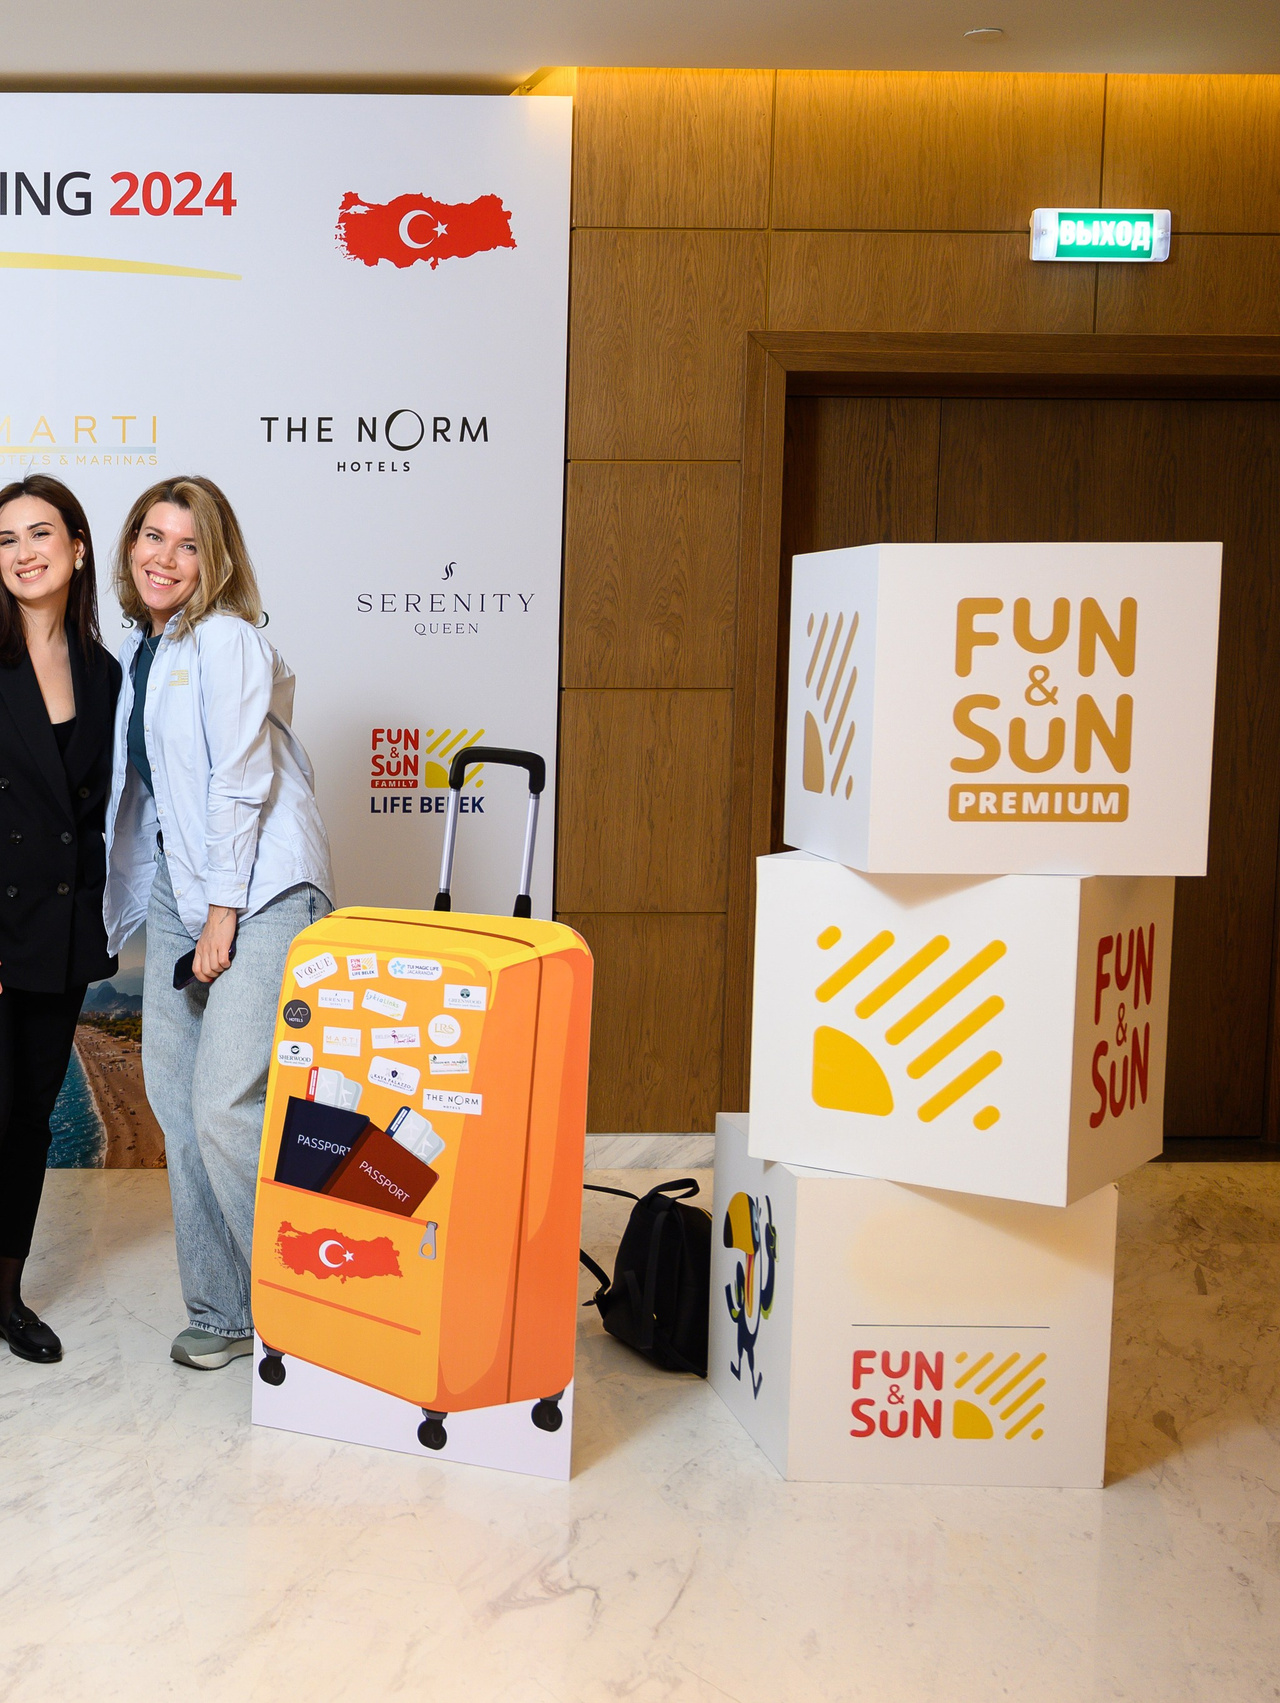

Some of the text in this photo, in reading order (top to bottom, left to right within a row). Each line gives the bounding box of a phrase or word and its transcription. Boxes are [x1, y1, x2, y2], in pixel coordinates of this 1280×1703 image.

[110, 171, 237, 217] 2024
[1060, 220, 1150, 251] ВЫХОД
[260, 408, 489, 451] THE NORM
[59, 455, 69, 465] &
[76, 455, 158, 466] MARINAS
[337, 461, 411, 472] HOTELS
[357, 593, 535, 613] SERENITY
[414, 623, 479, 635] QUEEN
[955, 597, 1137, 677] FUN
[1025, 665, 1059, 706] &
[372, 729, 419, 750] FUN
[950, 694, 1134, 773] SUN
[371, 754, 418, 776] SUN
[390, 747, 399, 758] &
[371, 797, 412, 813] LIFE
[958, 792, 1119, 815] PREMIUM
[1094, 922, 1155, 1026] FUN
[1116, 1002, 1128, 1047] &
[1089, 1021, 1150, 1129] SUN
[427, 1093, 479, 1106] THE NORM
[359, 1160, 410, 1203] PASSPORT
[852, 1350, 944, 1391] FUN
[888, 1384, 905, 1405] &
[850, 1399, 943, 1439] SUN
